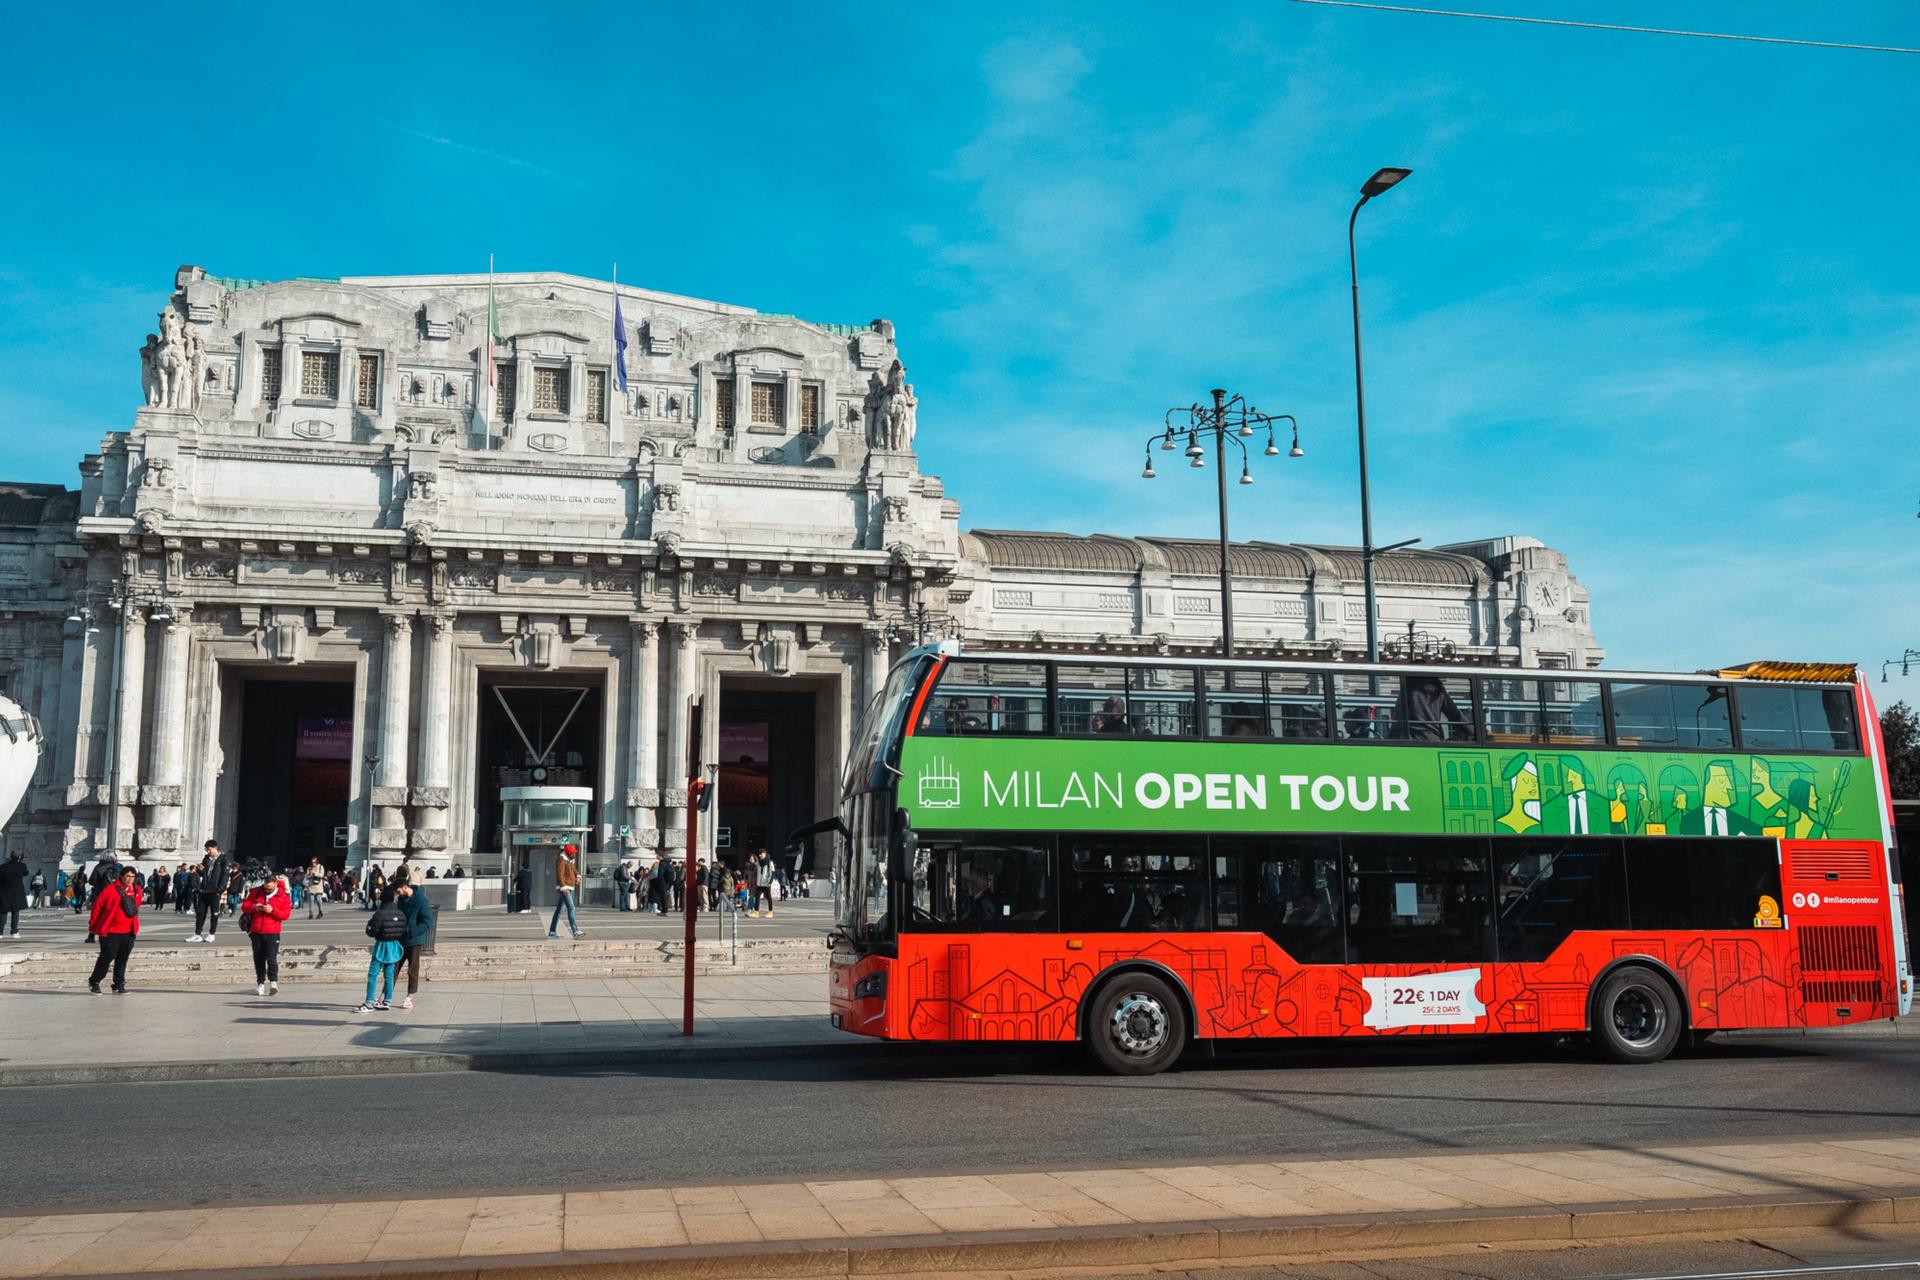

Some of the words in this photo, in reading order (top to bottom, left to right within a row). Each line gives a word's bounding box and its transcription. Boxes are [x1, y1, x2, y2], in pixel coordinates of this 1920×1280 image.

[984, 771, 1122, 808] MILAN
[1135, 772, 1267, 809] OPEN
[1280, 774, 1410, 811] TOUR
[1823, 896, 1879, 905] #milanopentour
[1393, 988, 1425, 1004] 22€
[1429, 990, 1435, 1001] 1
[1437, 990, 1461, 1001] DAY
[1442, 1005, 1461, 1013] DAYS
